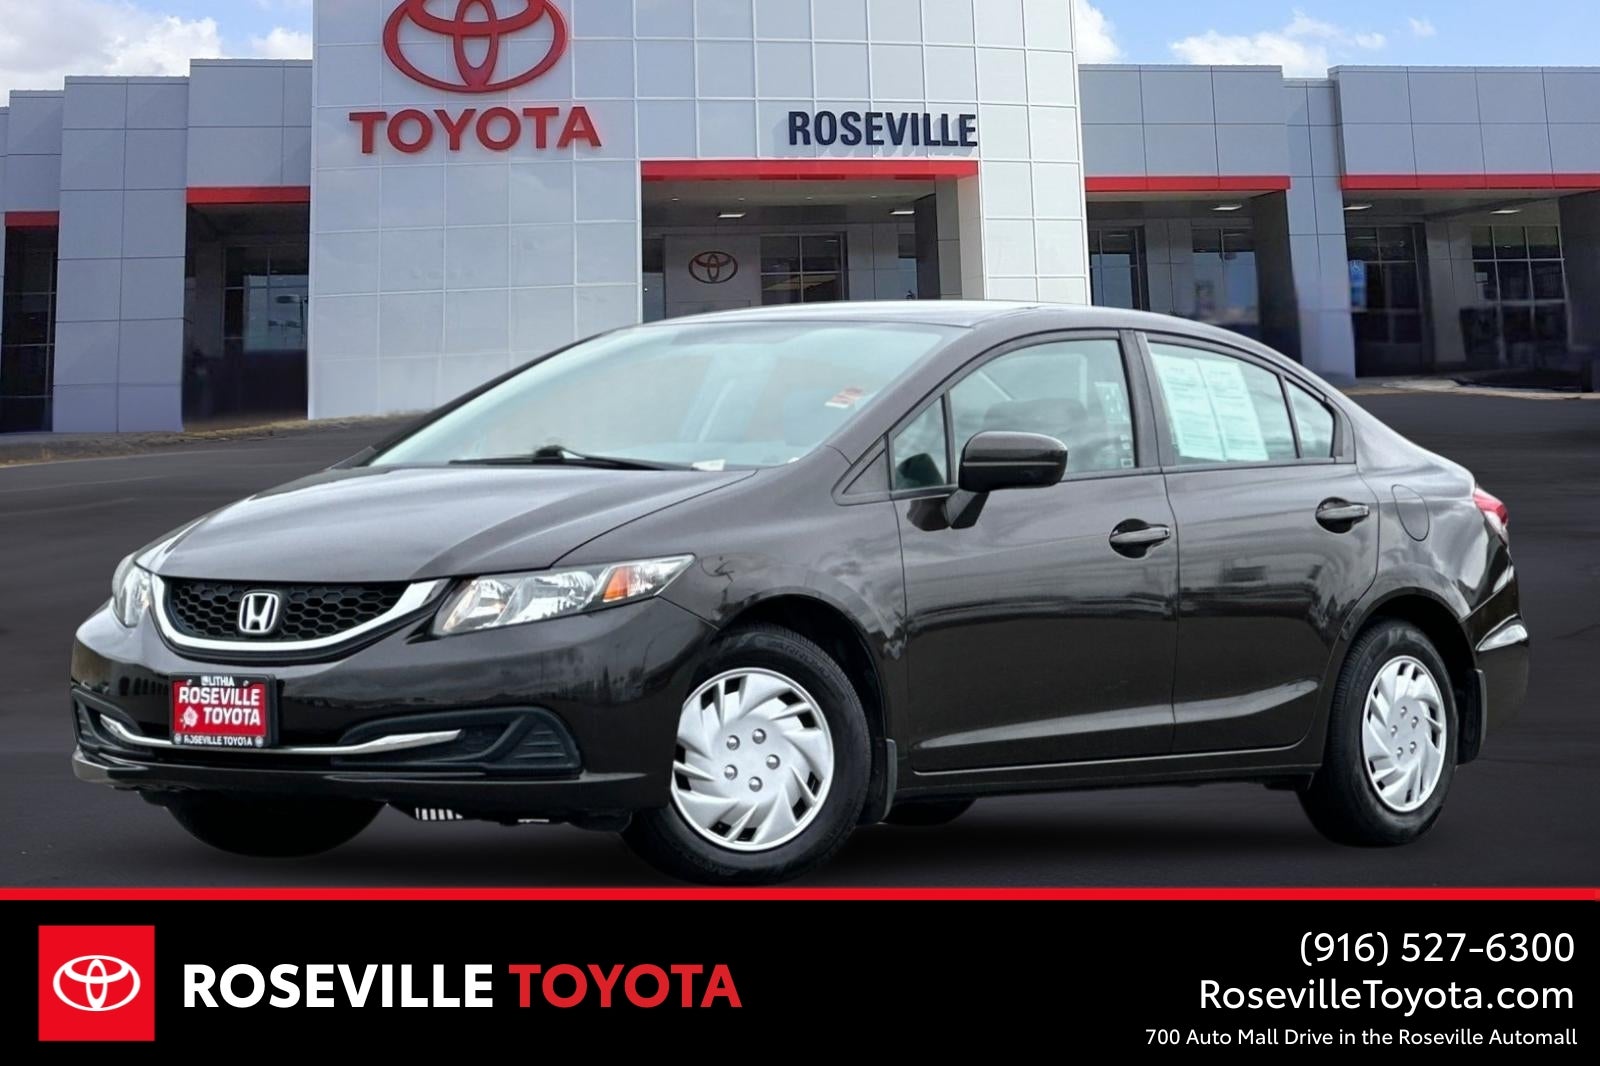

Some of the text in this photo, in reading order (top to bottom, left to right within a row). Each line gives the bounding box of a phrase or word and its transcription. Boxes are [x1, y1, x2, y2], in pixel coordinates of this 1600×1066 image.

[349, 106, 602, 153] TOYOTA
[788, 111, 978, 147] ROSEVILLE
[209, 676, 235, 687] LITHIA
[178, 686, 261, 706] ROSEVILLE
[203, 707, 260, 726] TOYOTA
